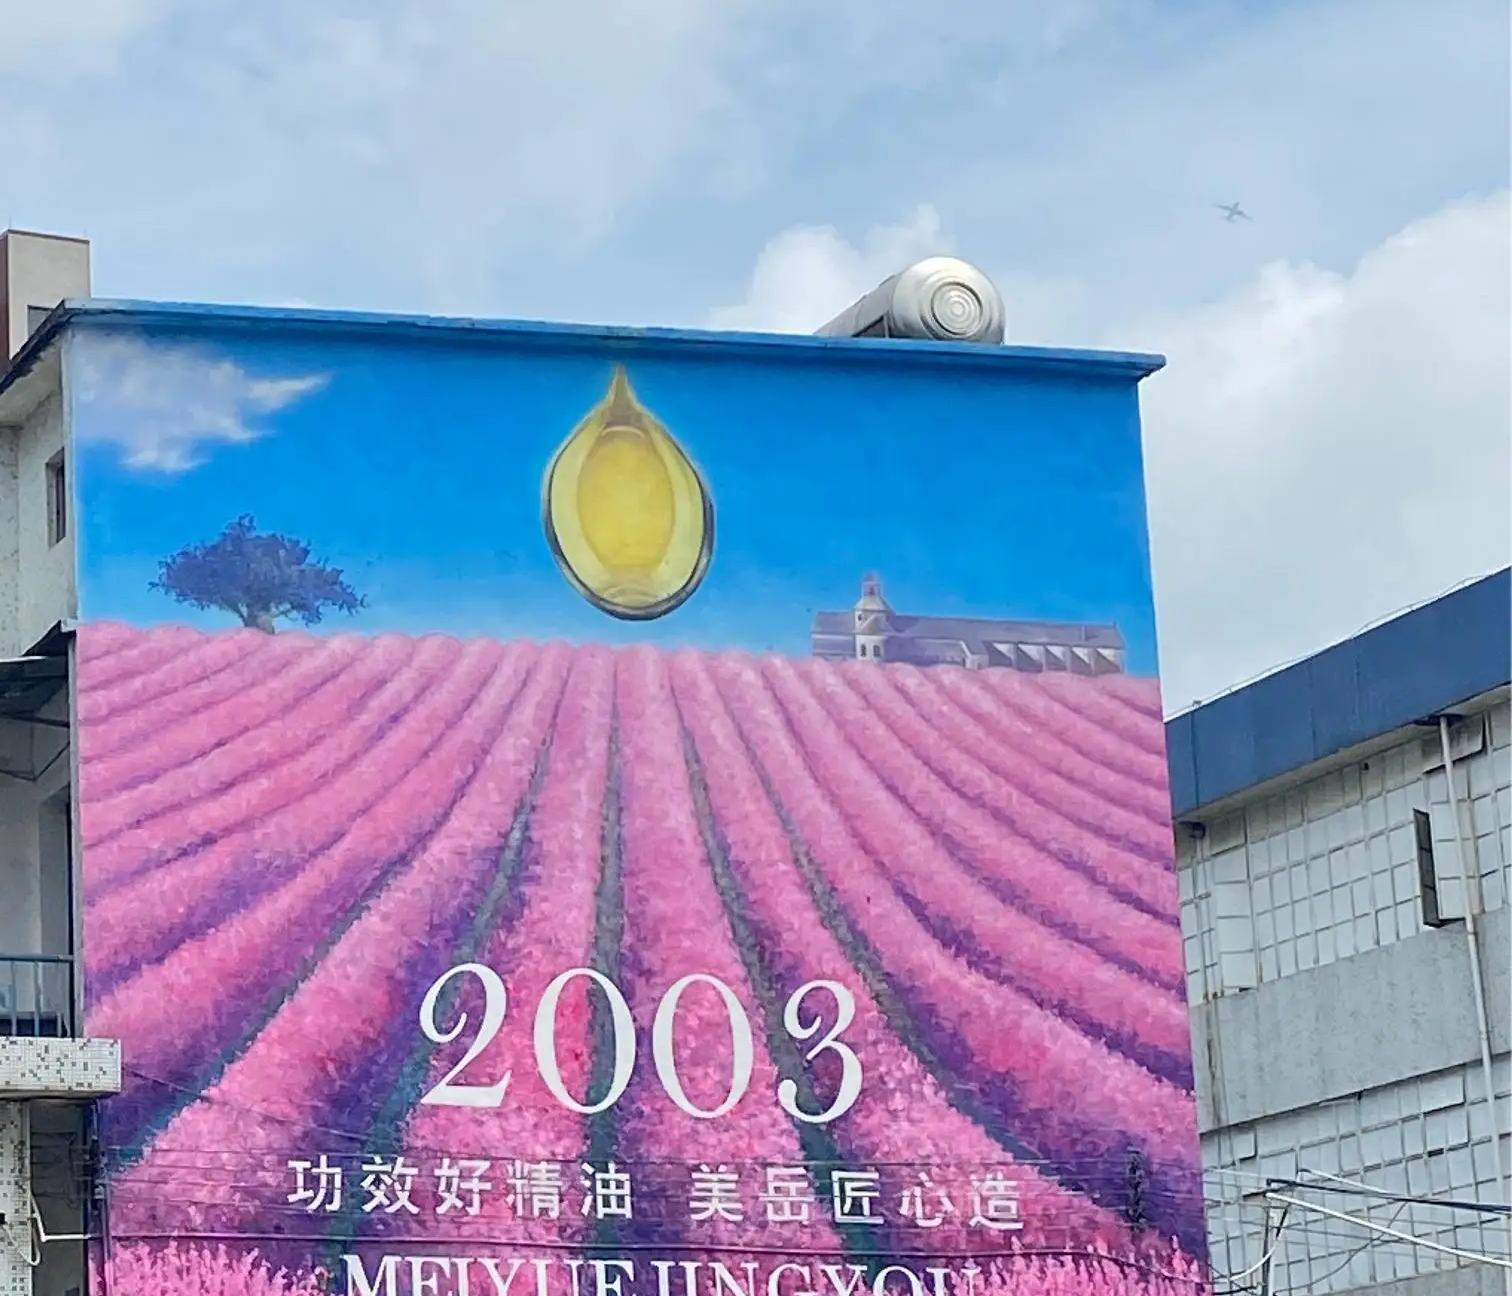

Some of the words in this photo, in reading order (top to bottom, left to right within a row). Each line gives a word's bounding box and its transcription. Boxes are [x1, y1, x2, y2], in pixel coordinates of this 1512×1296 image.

[419, 962, 864, 1124] 2003
[287, 1154, 634, 1220] 功效好精油
[688, 1163, 1024, 1231] 美岳匠心造
